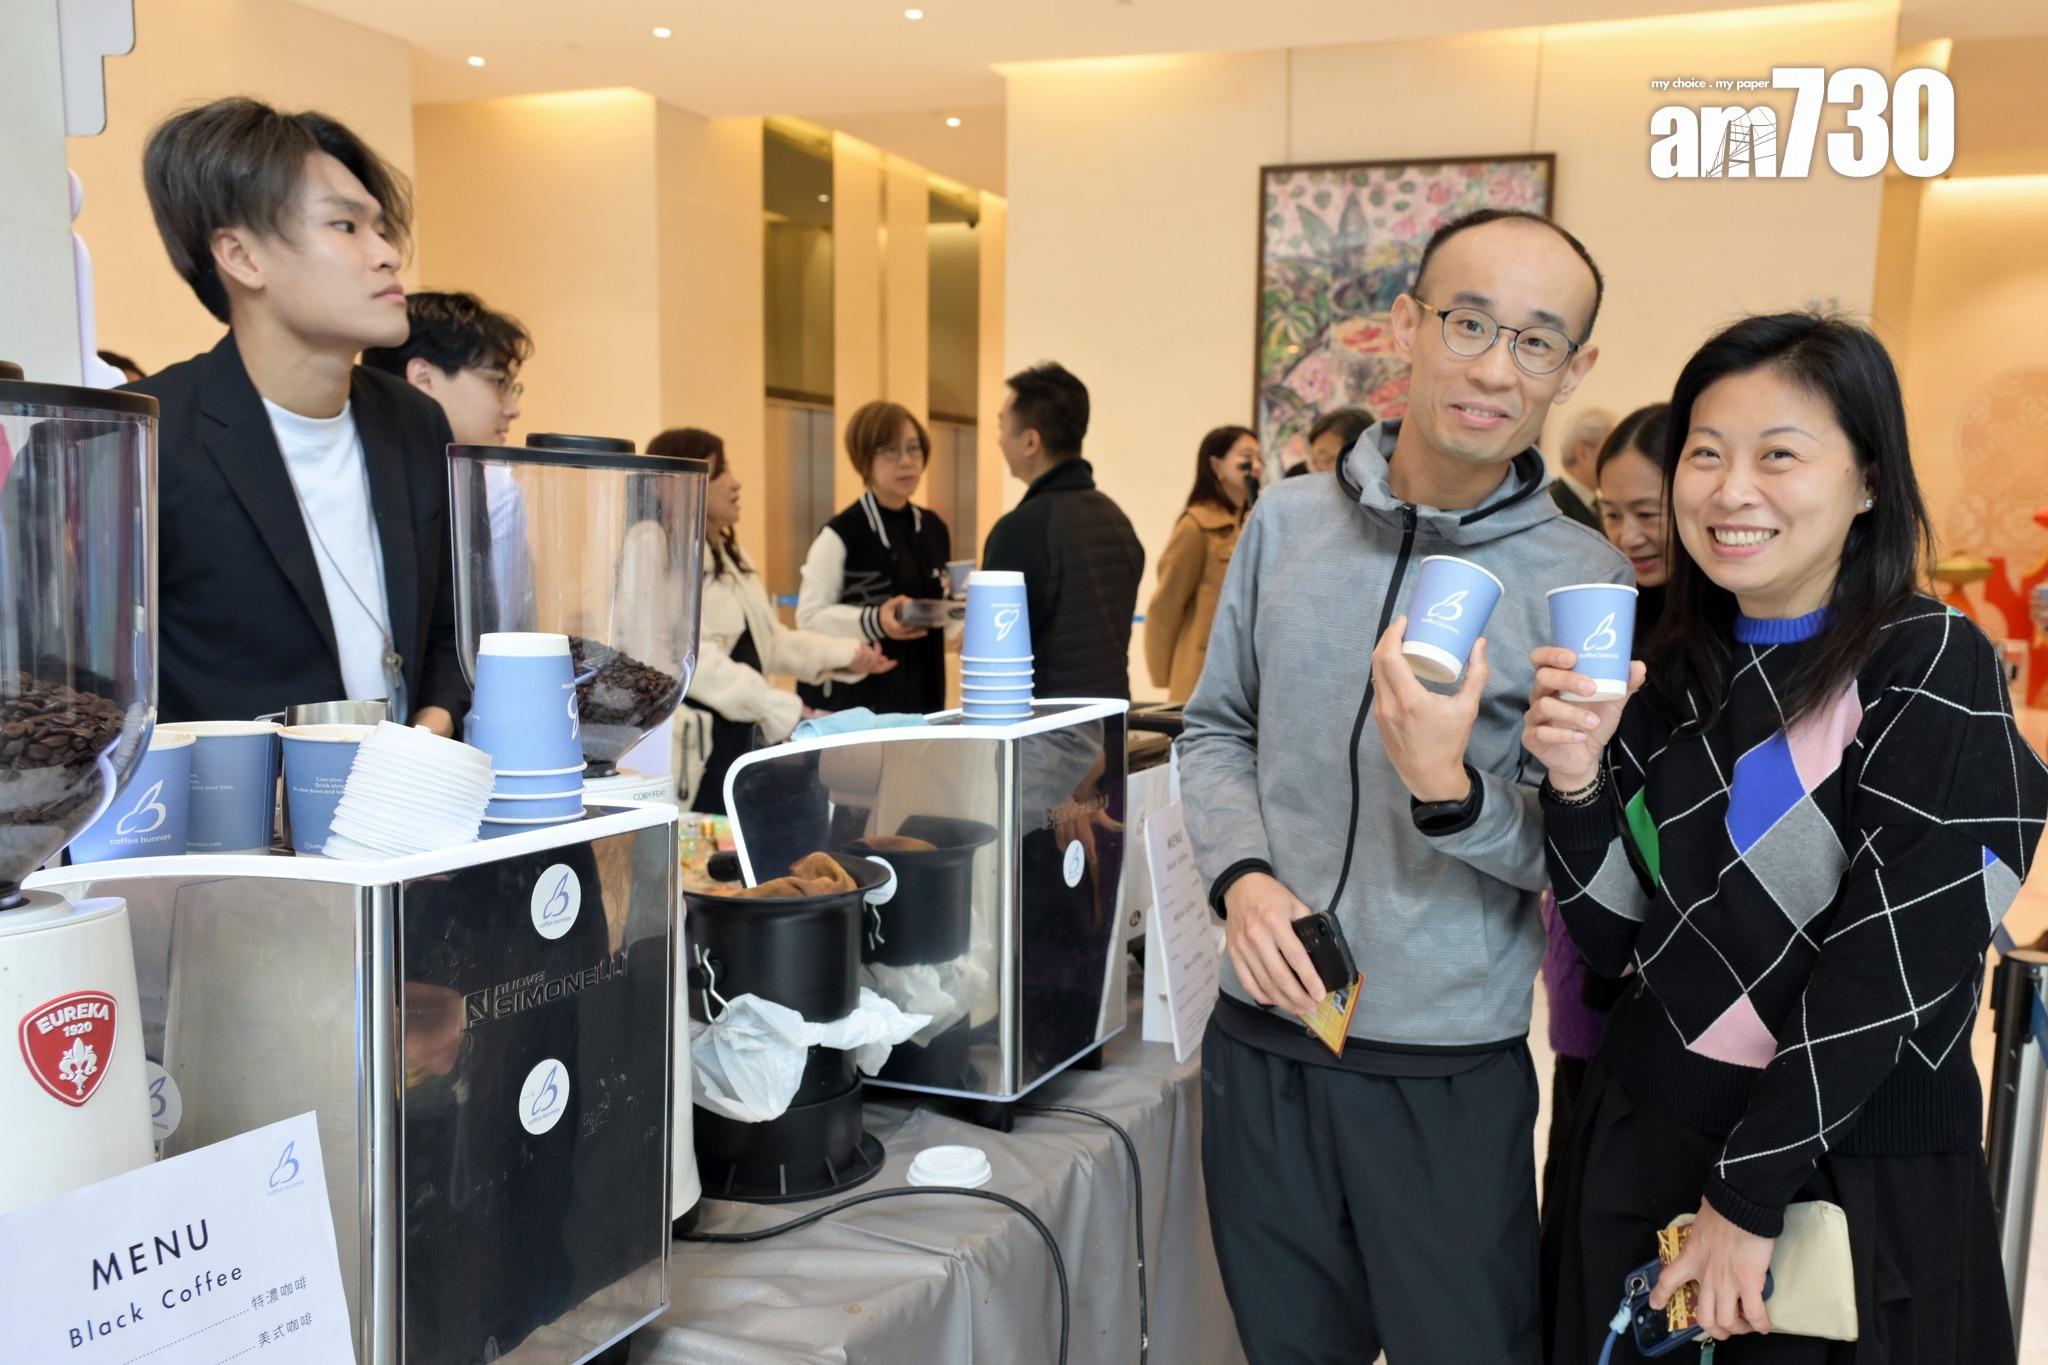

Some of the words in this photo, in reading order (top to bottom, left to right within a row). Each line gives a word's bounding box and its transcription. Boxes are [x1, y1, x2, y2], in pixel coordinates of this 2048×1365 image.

[110, 837, 139, 846] coffee
[140, 833, 172, 843] bunnies
[495, 951, 629, 1020] SIMONELLI
[36, 1003, 110, 1035] EUREKA
[63, 1021, 93, 1038] 1920
[92, 1218, 210, 1291] MENU
[69, 1302, 144, 1349] Black
[162, 1264, 242, 1309] Coffee
[251, 1274, 308, 1311] 特濃咖啡
[258, 1311, 313, 1348] 美式咖啡
